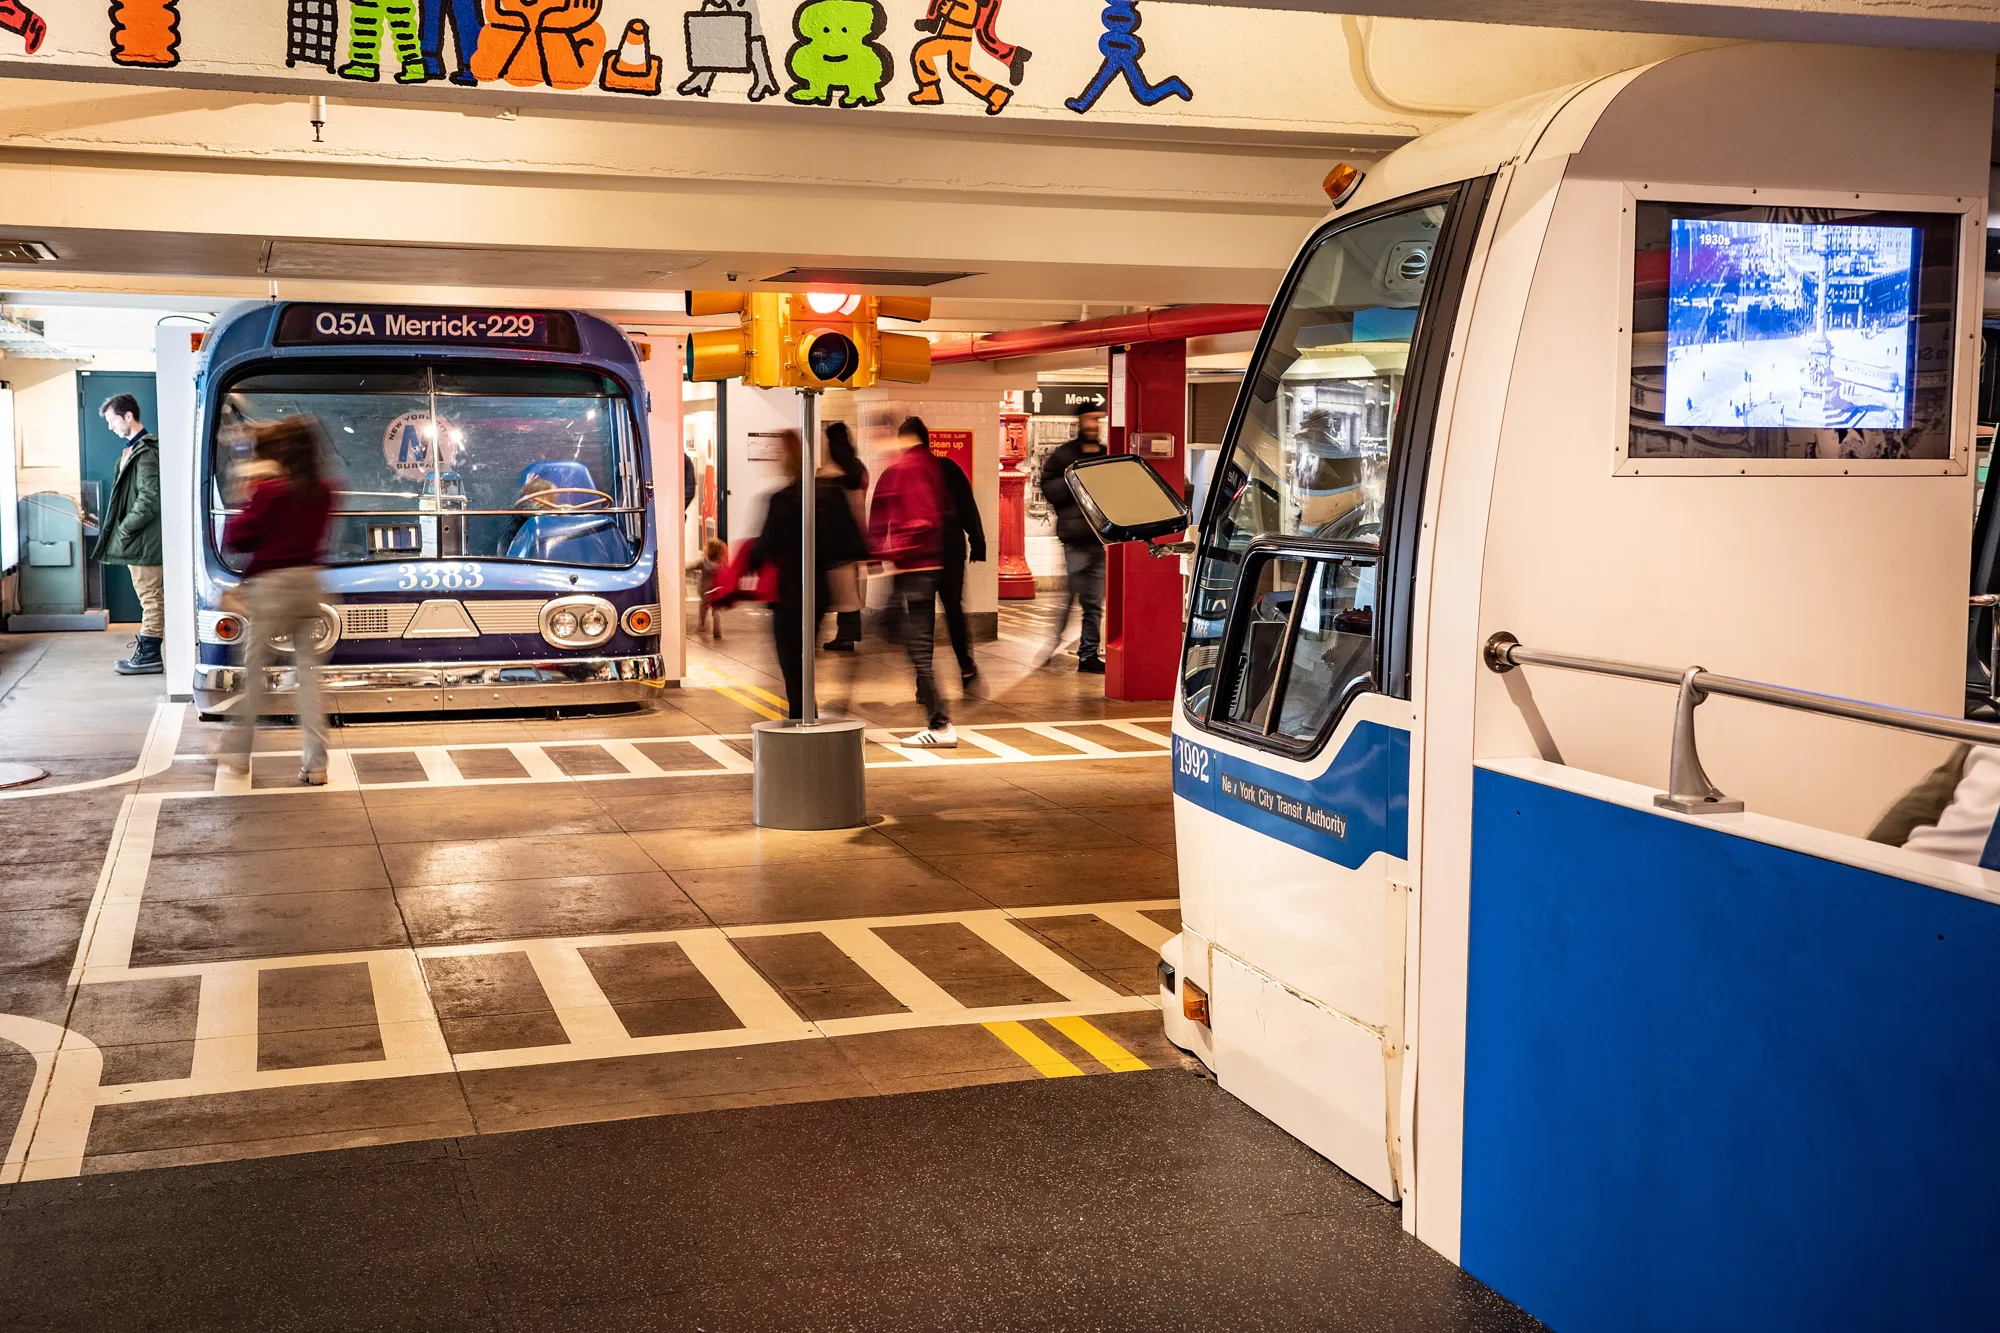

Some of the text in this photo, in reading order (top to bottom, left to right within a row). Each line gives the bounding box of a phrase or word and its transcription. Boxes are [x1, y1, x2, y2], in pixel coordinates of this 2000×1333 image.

[1699, 233, 1731, 246] 1930s
[316, 312, 535, 337] Q5A Merrick-229
[1065, 393, 1090, 404] Men
[389, 421, 402, 440] NEW
[929, 440, 964, 450] clean up
[398, 563, 484, 590] 3383
[1178, 739, 1210, 783] 1992
[1239, 781, 1256, 802] York
[1258, 788, 1274, 811] City
[1276, 793, 1303, 820] Transit
[1305, 804, 1347, 839] Authority
